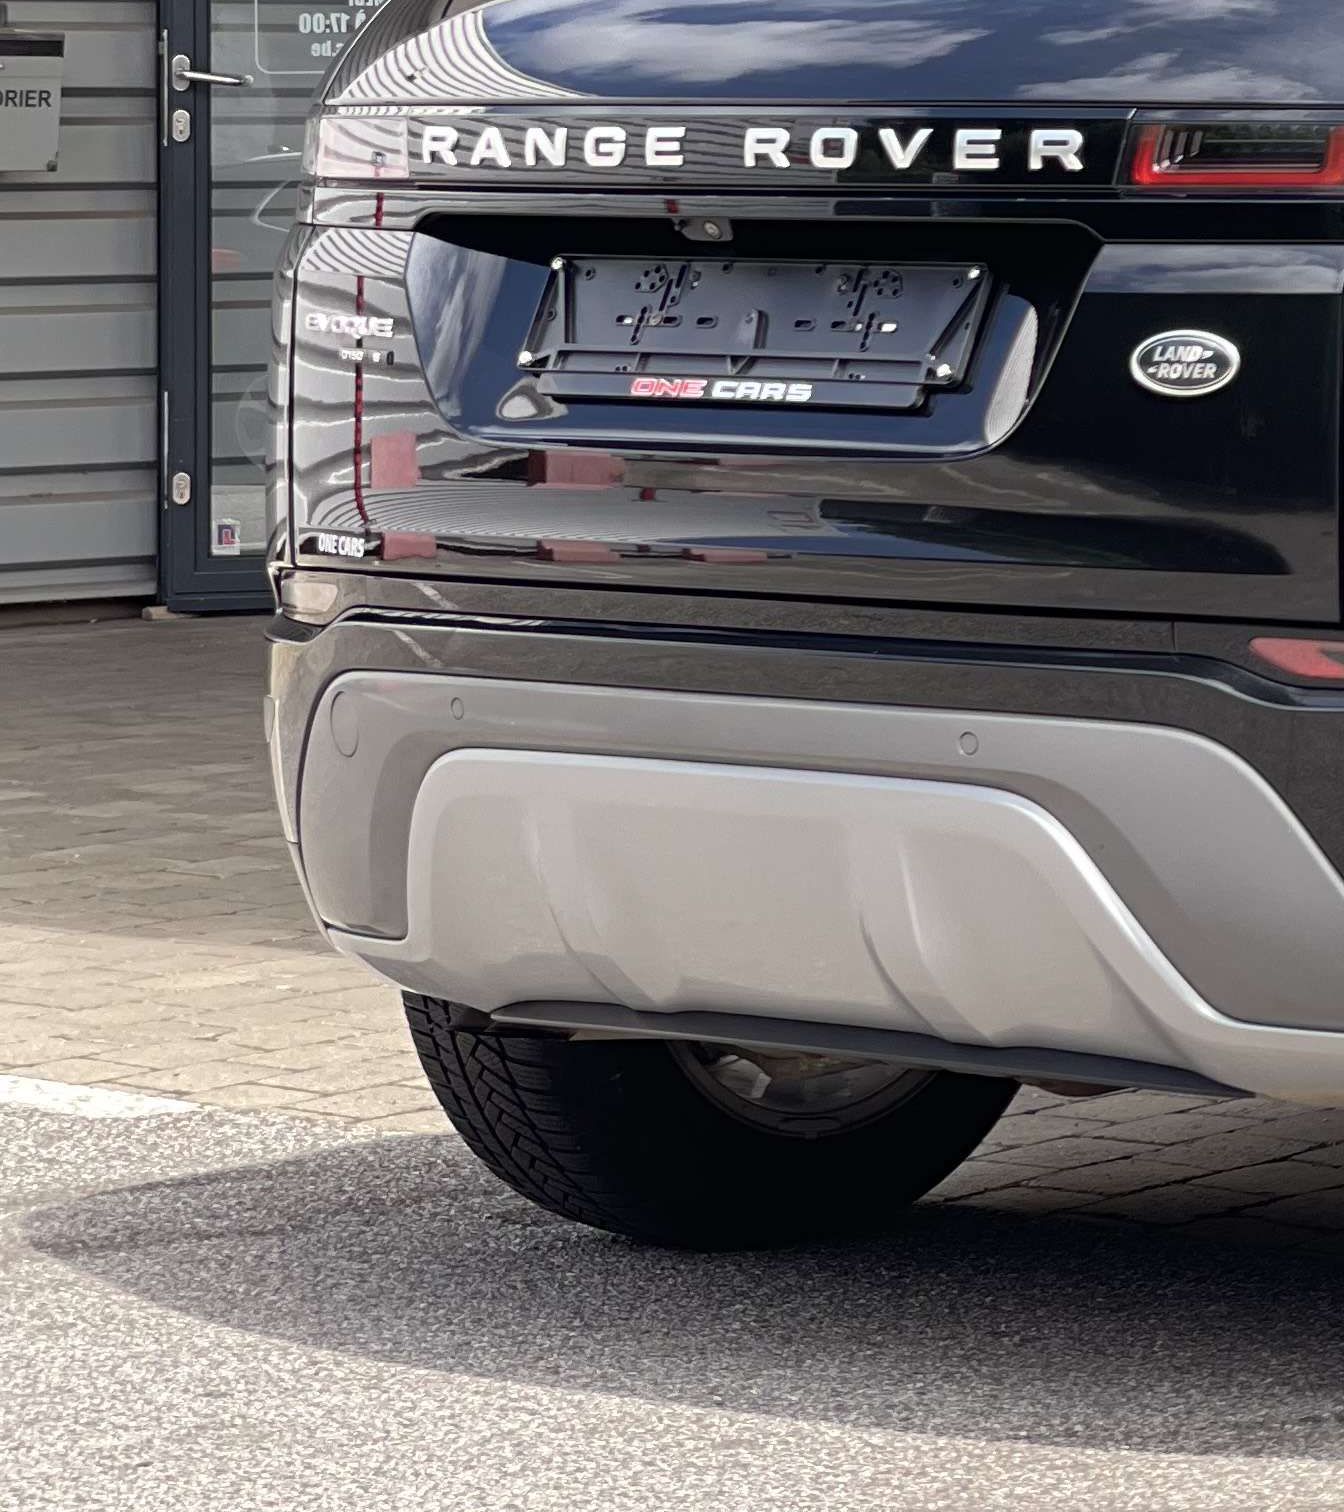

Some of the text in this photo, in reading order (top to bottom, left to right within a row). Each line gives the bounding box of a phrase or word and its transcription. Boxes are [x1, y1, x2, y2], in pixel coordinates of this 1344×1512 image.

[0, 89, 52, 108] RIER
[420, 126, 1084, 172] RANGE ROVER
[1152, 345, 1204, 362] LAND
[1156, 362, 1218, 379] ROVER
[631, 377, 813, 403] ONE CARS
[319, 533, 366, 558] ONE CARS
